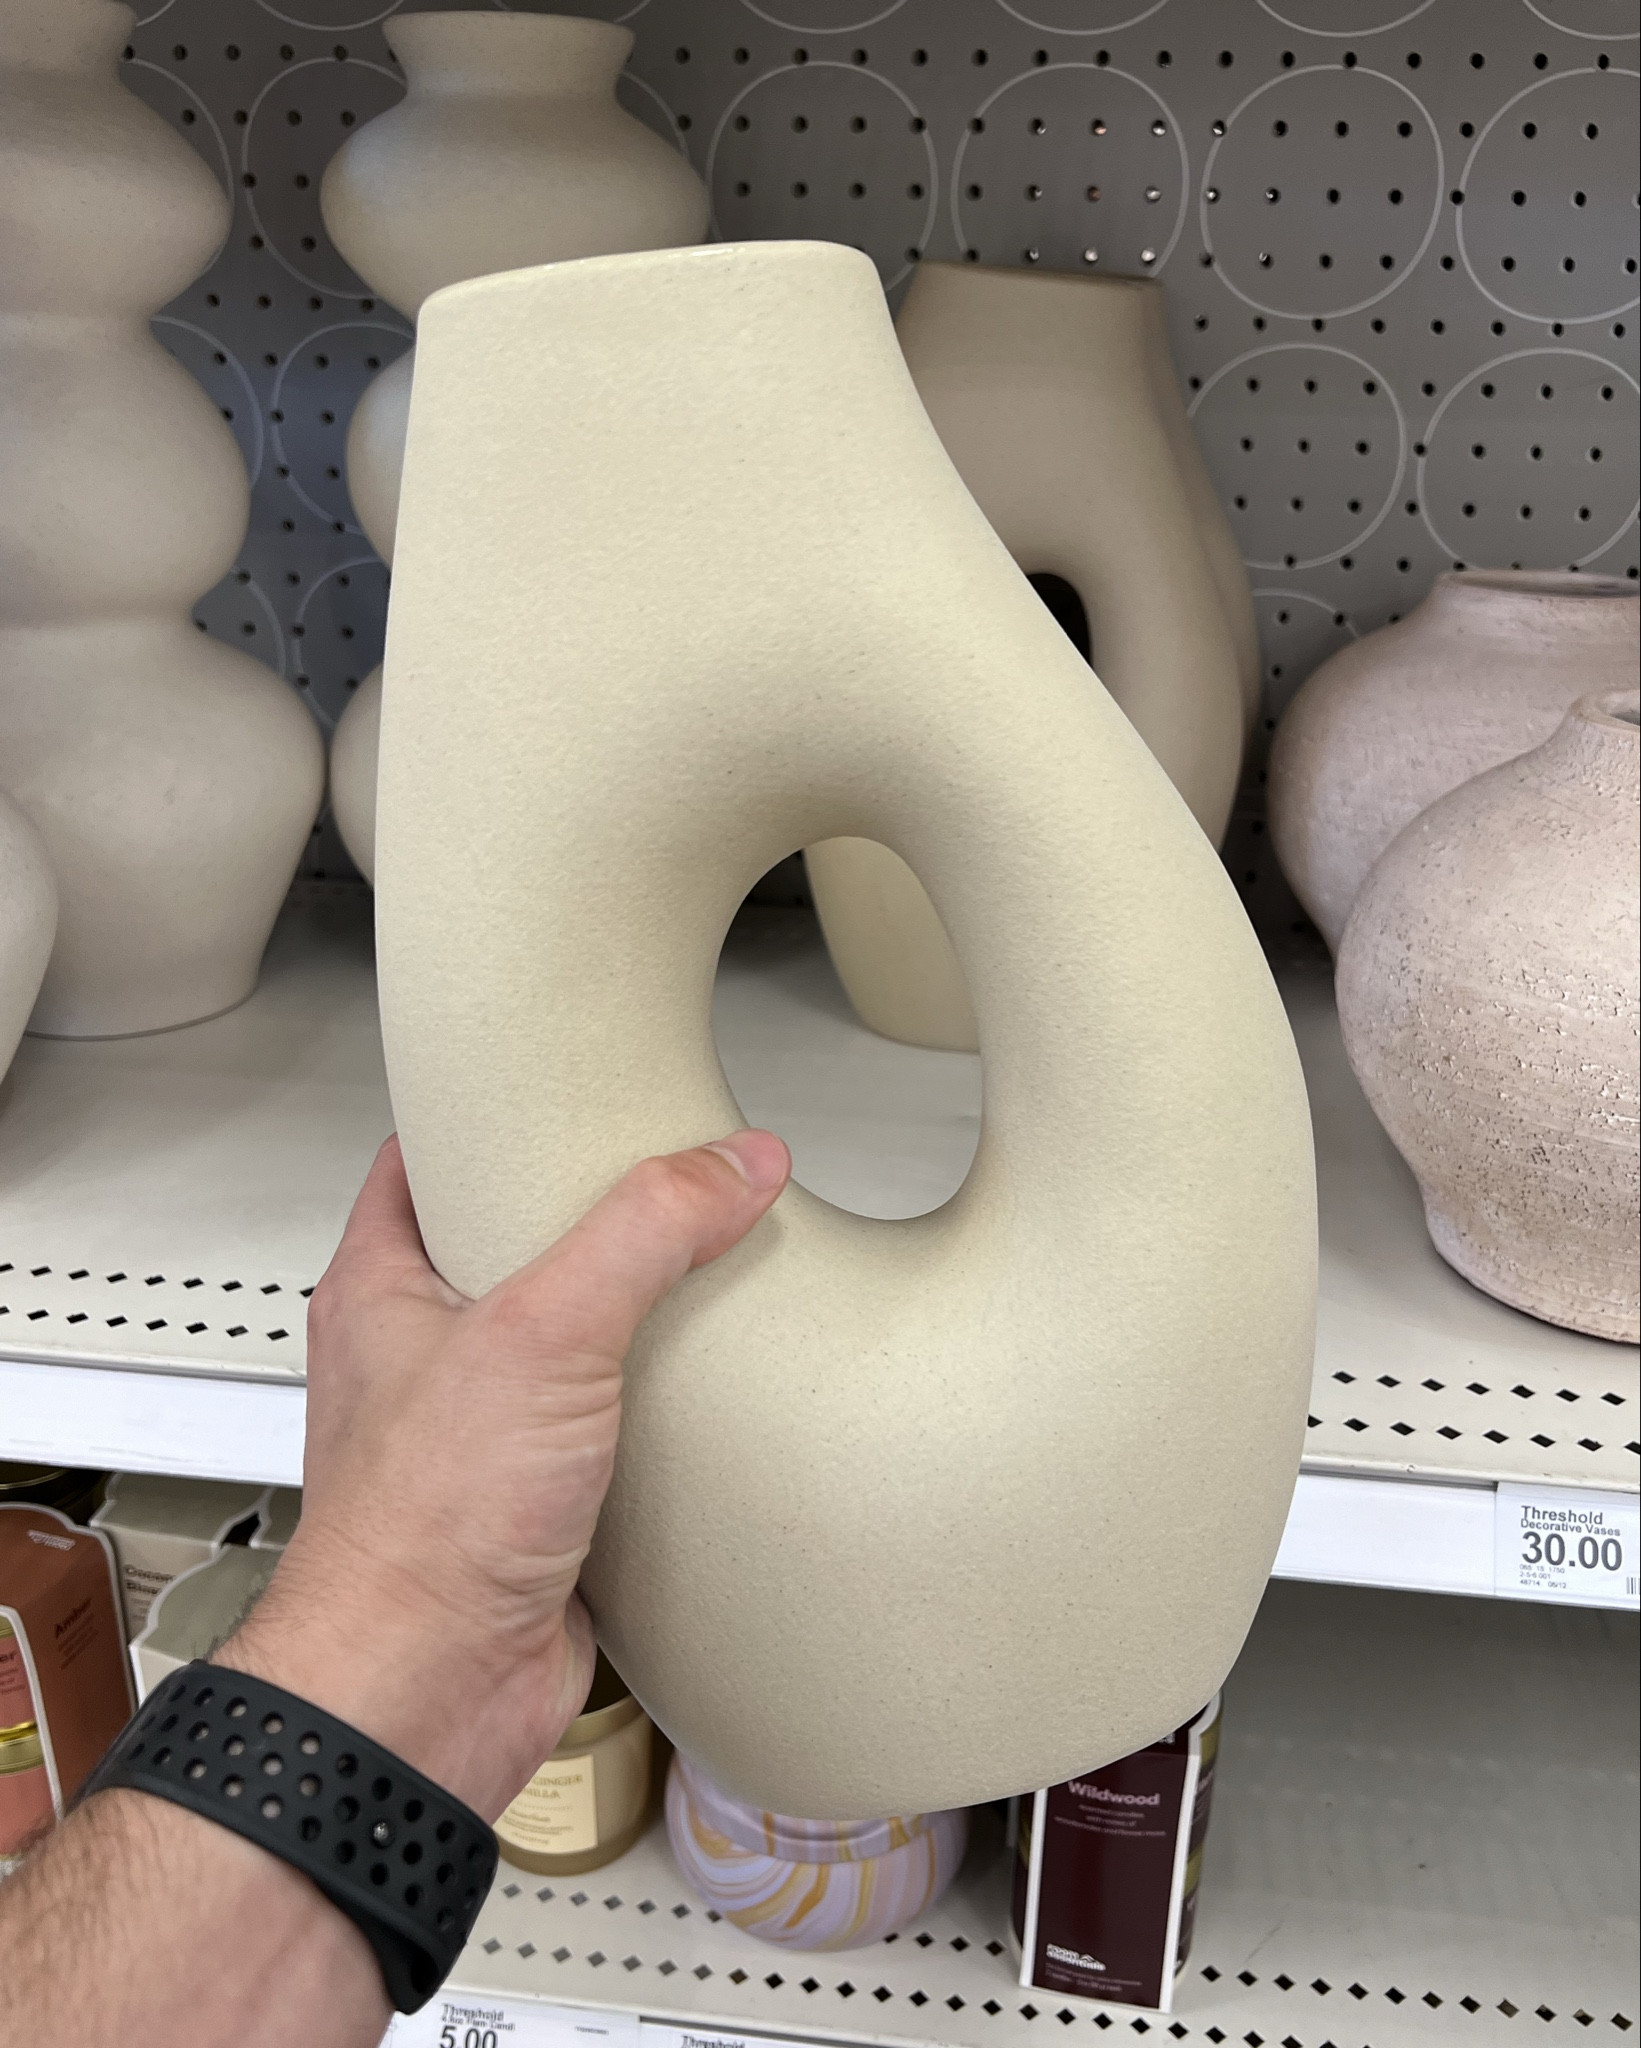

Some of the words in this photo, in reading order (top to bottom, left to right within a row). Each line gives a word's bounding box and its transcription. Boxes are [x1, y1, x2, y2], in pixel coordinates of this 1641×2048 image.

[1521, 1505, 1603, 1525] Threshold
[1520, 1519, 1582, 1533] Decorative
[1585, 1524, 1621, 1536] Vases
[1521, 1531, 1622, 1571] 30.00
[523, 1787, 560, 1799] NILLA
[1068, 1780, 1160, 1806] Wildwood
[441, 2003, 504, 2021] Threshold
[440, 2025, 497, 2048] 500
